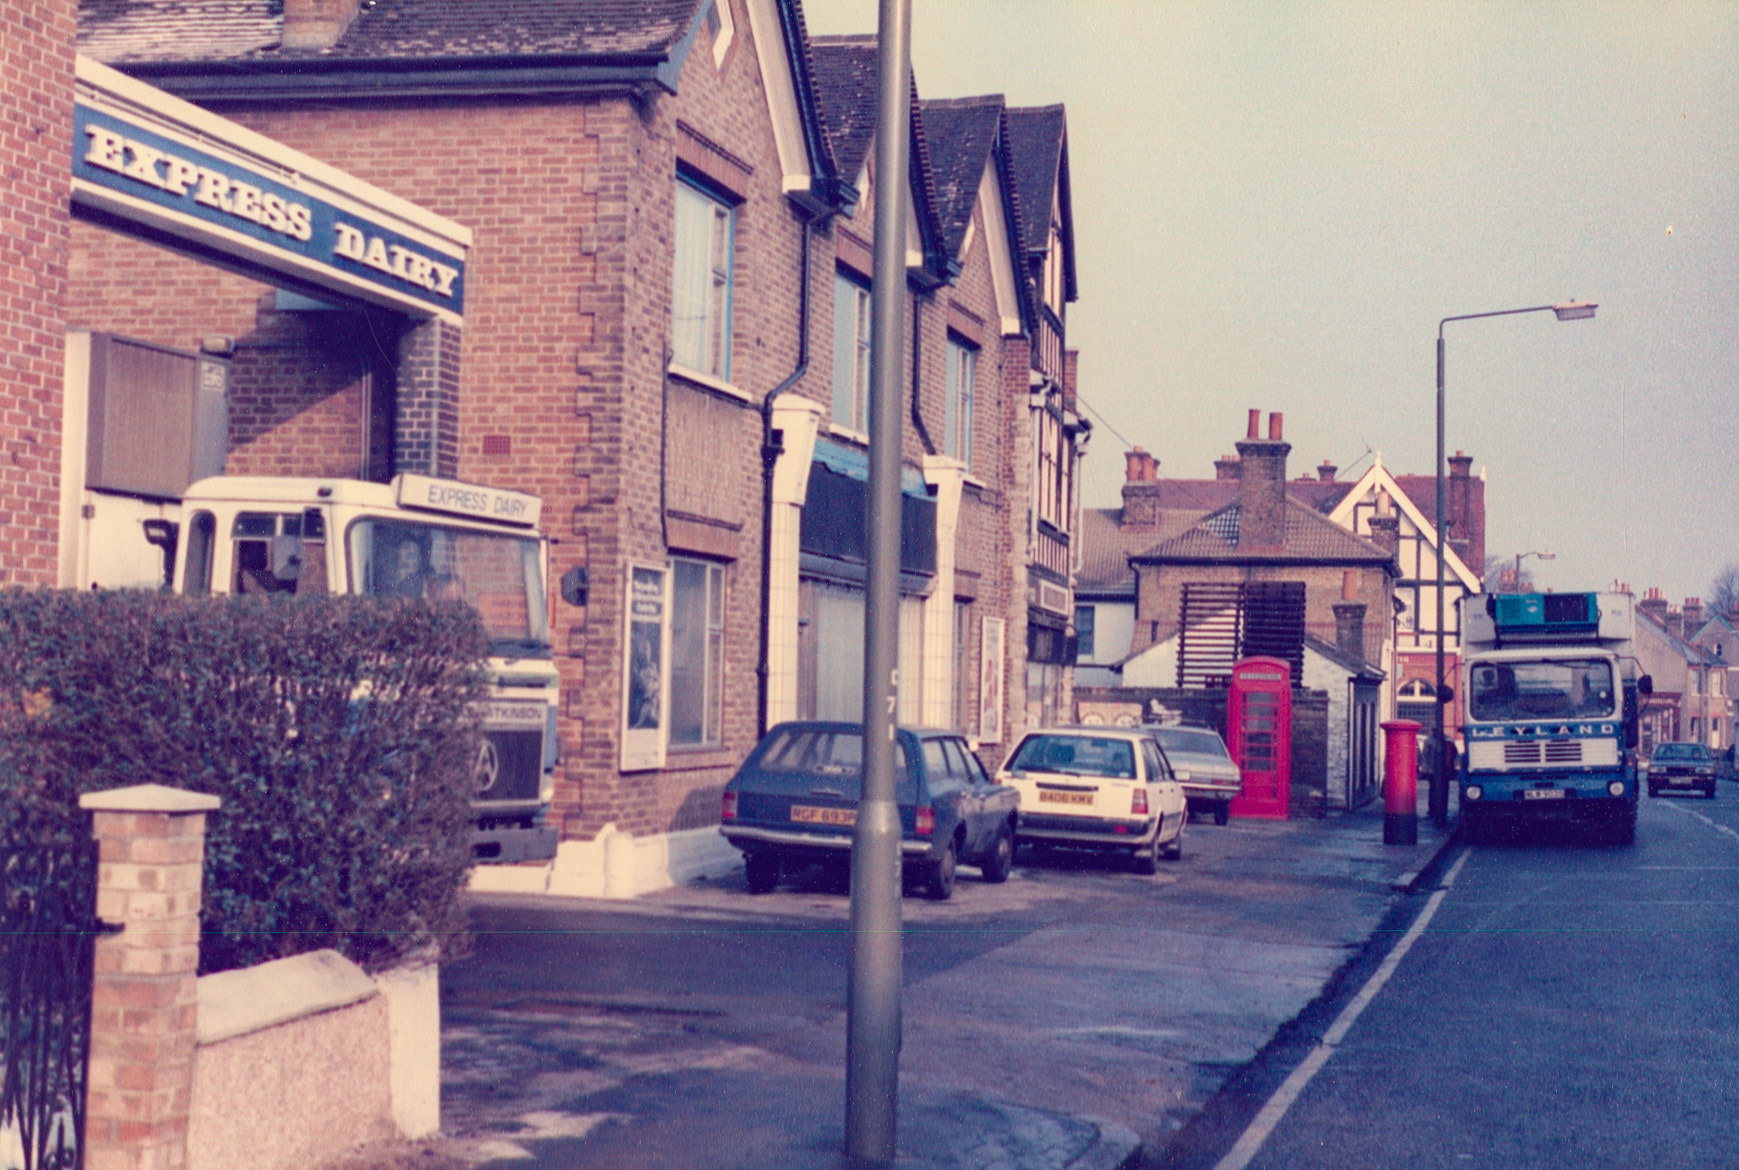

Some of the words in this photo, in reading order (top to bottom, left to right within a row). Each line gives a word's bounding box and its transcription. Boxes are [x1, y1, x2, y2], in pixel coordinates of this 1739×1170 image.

[83, 123, 313, 241] EXPRESS
[333, 221, 459, 298] DAIRY
[427, 484, 488, 511] EXPRESS
[493, 496, 528, 517] DAIRY
[1472, 724, 1614, 737] LEYLAND
[793, 808, 818, 820] RGF
